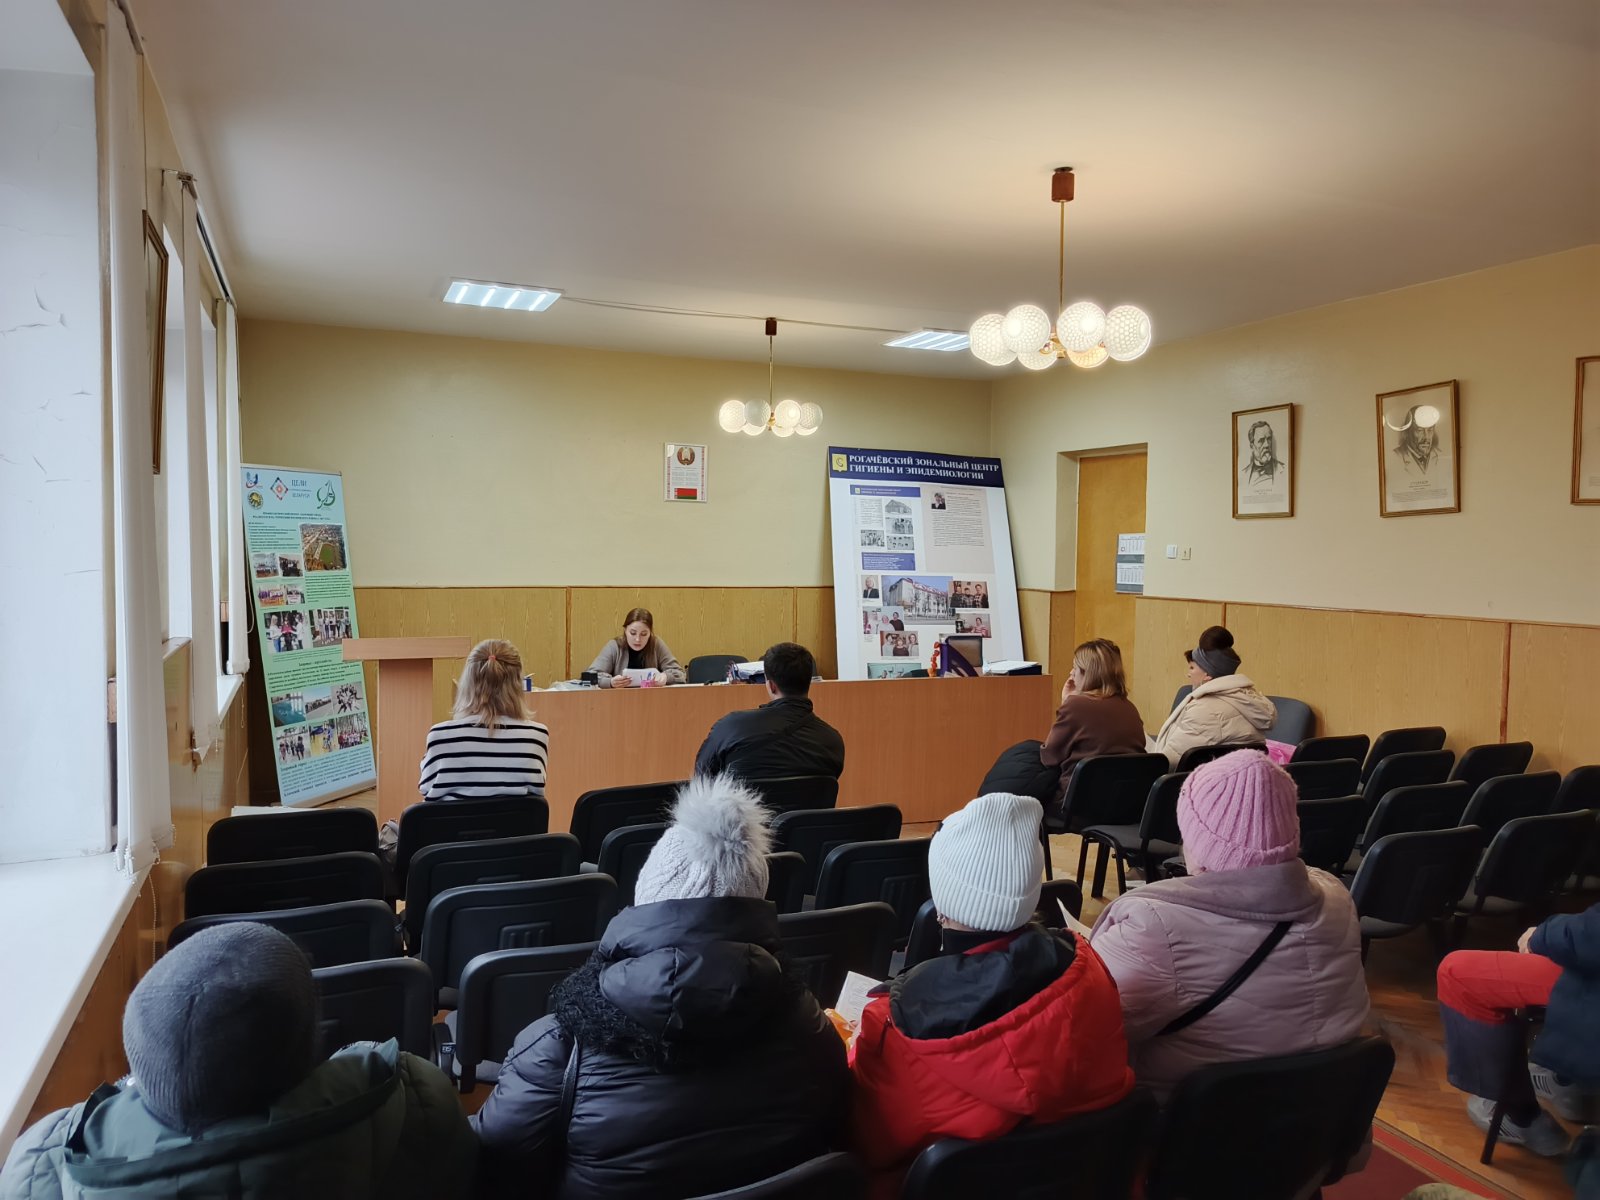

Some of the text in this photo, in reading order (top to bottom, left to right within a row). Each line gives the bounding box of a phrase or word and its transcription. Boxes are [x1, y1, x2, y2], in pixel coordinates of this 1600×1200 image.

[849, 455, 999, 472] РОГАЧЁВСКИЙ ЗОНАЛЬНЫЙ ЦЕНТР
[850, 464, 984, 479] ГИГИЕНЫ И ЭПИДЕМИОЛОГИИ
